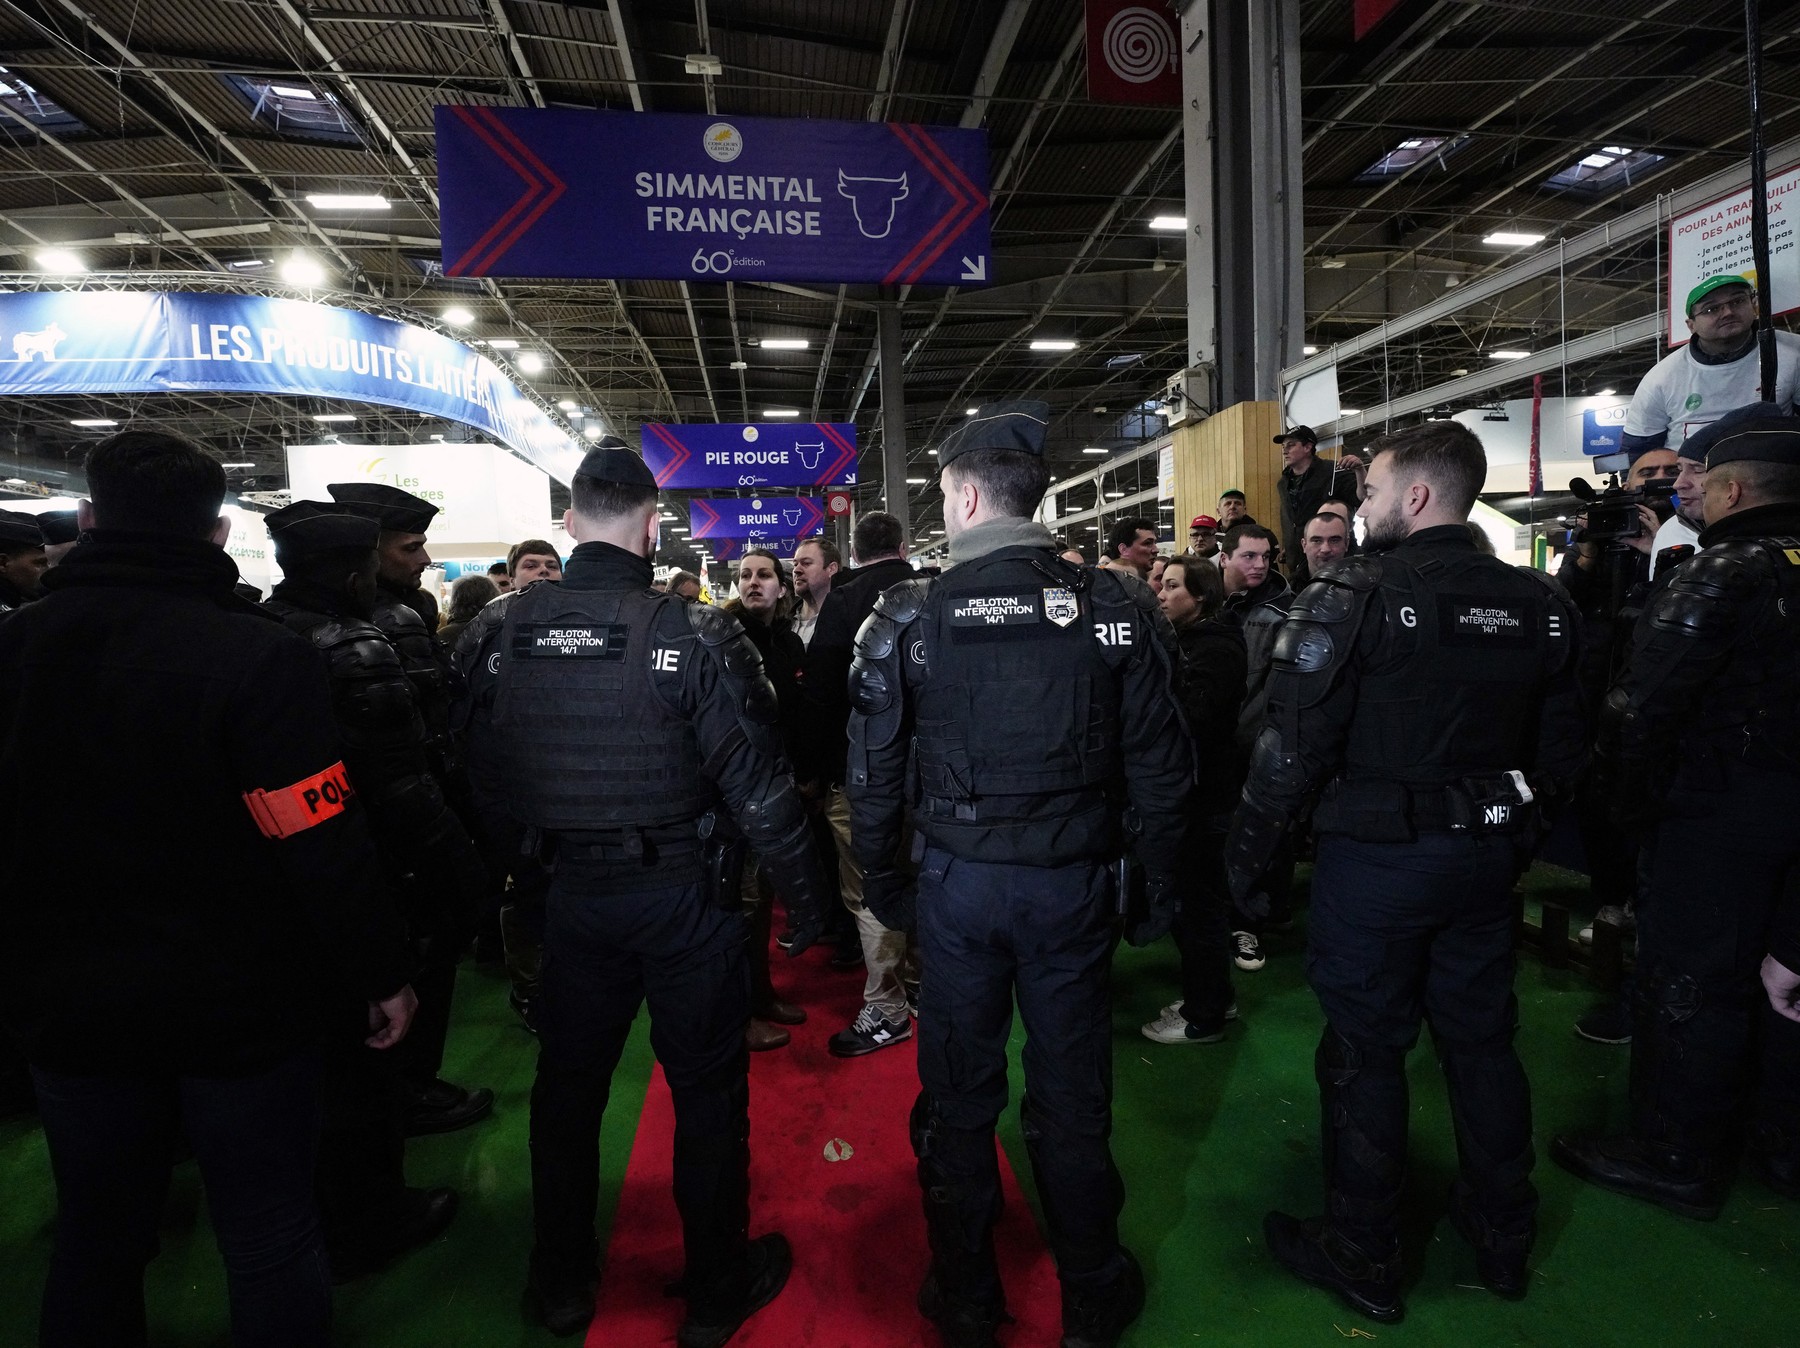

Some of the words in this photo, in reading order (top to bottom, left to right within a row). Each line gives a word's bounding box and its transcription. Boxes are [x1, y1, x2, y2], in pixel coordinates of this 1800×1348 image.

[635, 171, 822, 203] SIMMENTAL
[647, 206, 822, 240] FRANÇAISE
[1678, 218, 1708, 237] POUR
[1710, 211, 1724, 224] LA
[1702, 226, 1723, 241] DES
[1701, 248, 1711, 258] Je
[1712, 238, 1735, 252] reste
[1701, 260, 1711, 270] Je
[1712, 255, 1724, 263] ne
[1725, 249, 1738, 258] les
[1774, 229, 1793, 243] pas
[733, 257, 766, 267] édition
[1701, 271, 1711, 281] Je
[1712, 267, 1724, 275] ne
[1725, 261, 1738, 270] les
[1775, 241, 1794, 255] pas
[190, 323, 253, 362] LES
[261, 326, 413, 384] PRODUITS
[705, 451, 731, 465] PIE
[734, 451, 790, 465] ROUGE
[395, 473, 420, 487] Les
[738, 514, 779, 525] BRUNE
[968, 597, 1018, 608] PELOTON
[954, 605, 1034, 618] INTERVENTION
[1399, 606, 1417, 628] G
[1470, 607, 1509, 618] PELOTON
[984, 614, 1006, 625] 14/1
[1459, 615, 1520, 627] INTERVENTION
[548, 629, 592, 639] PELOTON
[1481, 624, 1499, 634] 14/1
[536, 637, 604, 647] INTERVENTION
[560, 646, 578, 655] 14/1
